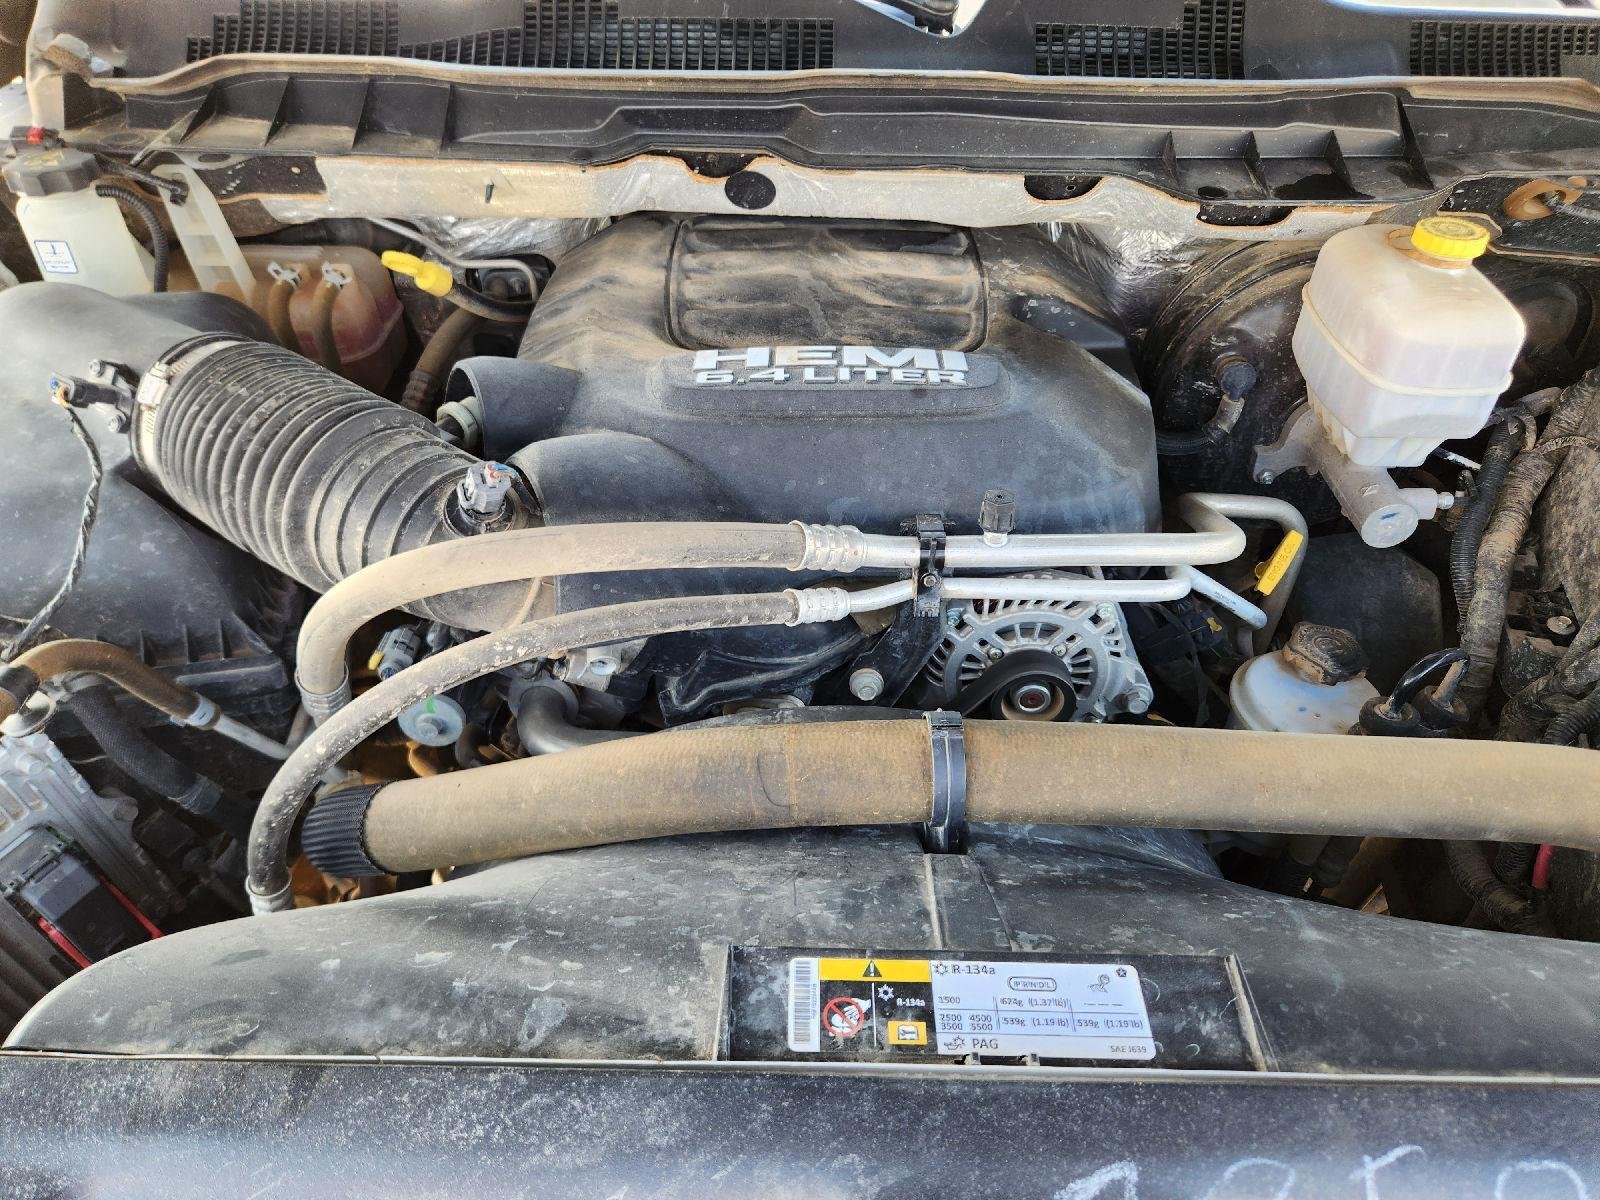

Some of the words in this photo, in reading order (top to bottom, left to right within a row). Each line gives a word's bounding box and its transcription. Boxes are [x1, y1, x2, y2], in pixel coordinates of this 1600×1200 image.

[693, 345, 969, 372] HEMI
[695, 367, 791, 385] 6.4
[803, 367, 970, 386] LITER
[952, 964, 996, 975] R-134a
[938, 996, 961, 1005] 1500
[969, 1014, 992, 1023] 4500
[1002, 1017, 1026, 1027] 539g
[941, 1022, 963, 1031] 3500
[970, 1023, 993, 1031] 5500
[972, 1038, 999, 1050] PAG
[1110, 1045, 1127, 1053] SAE
